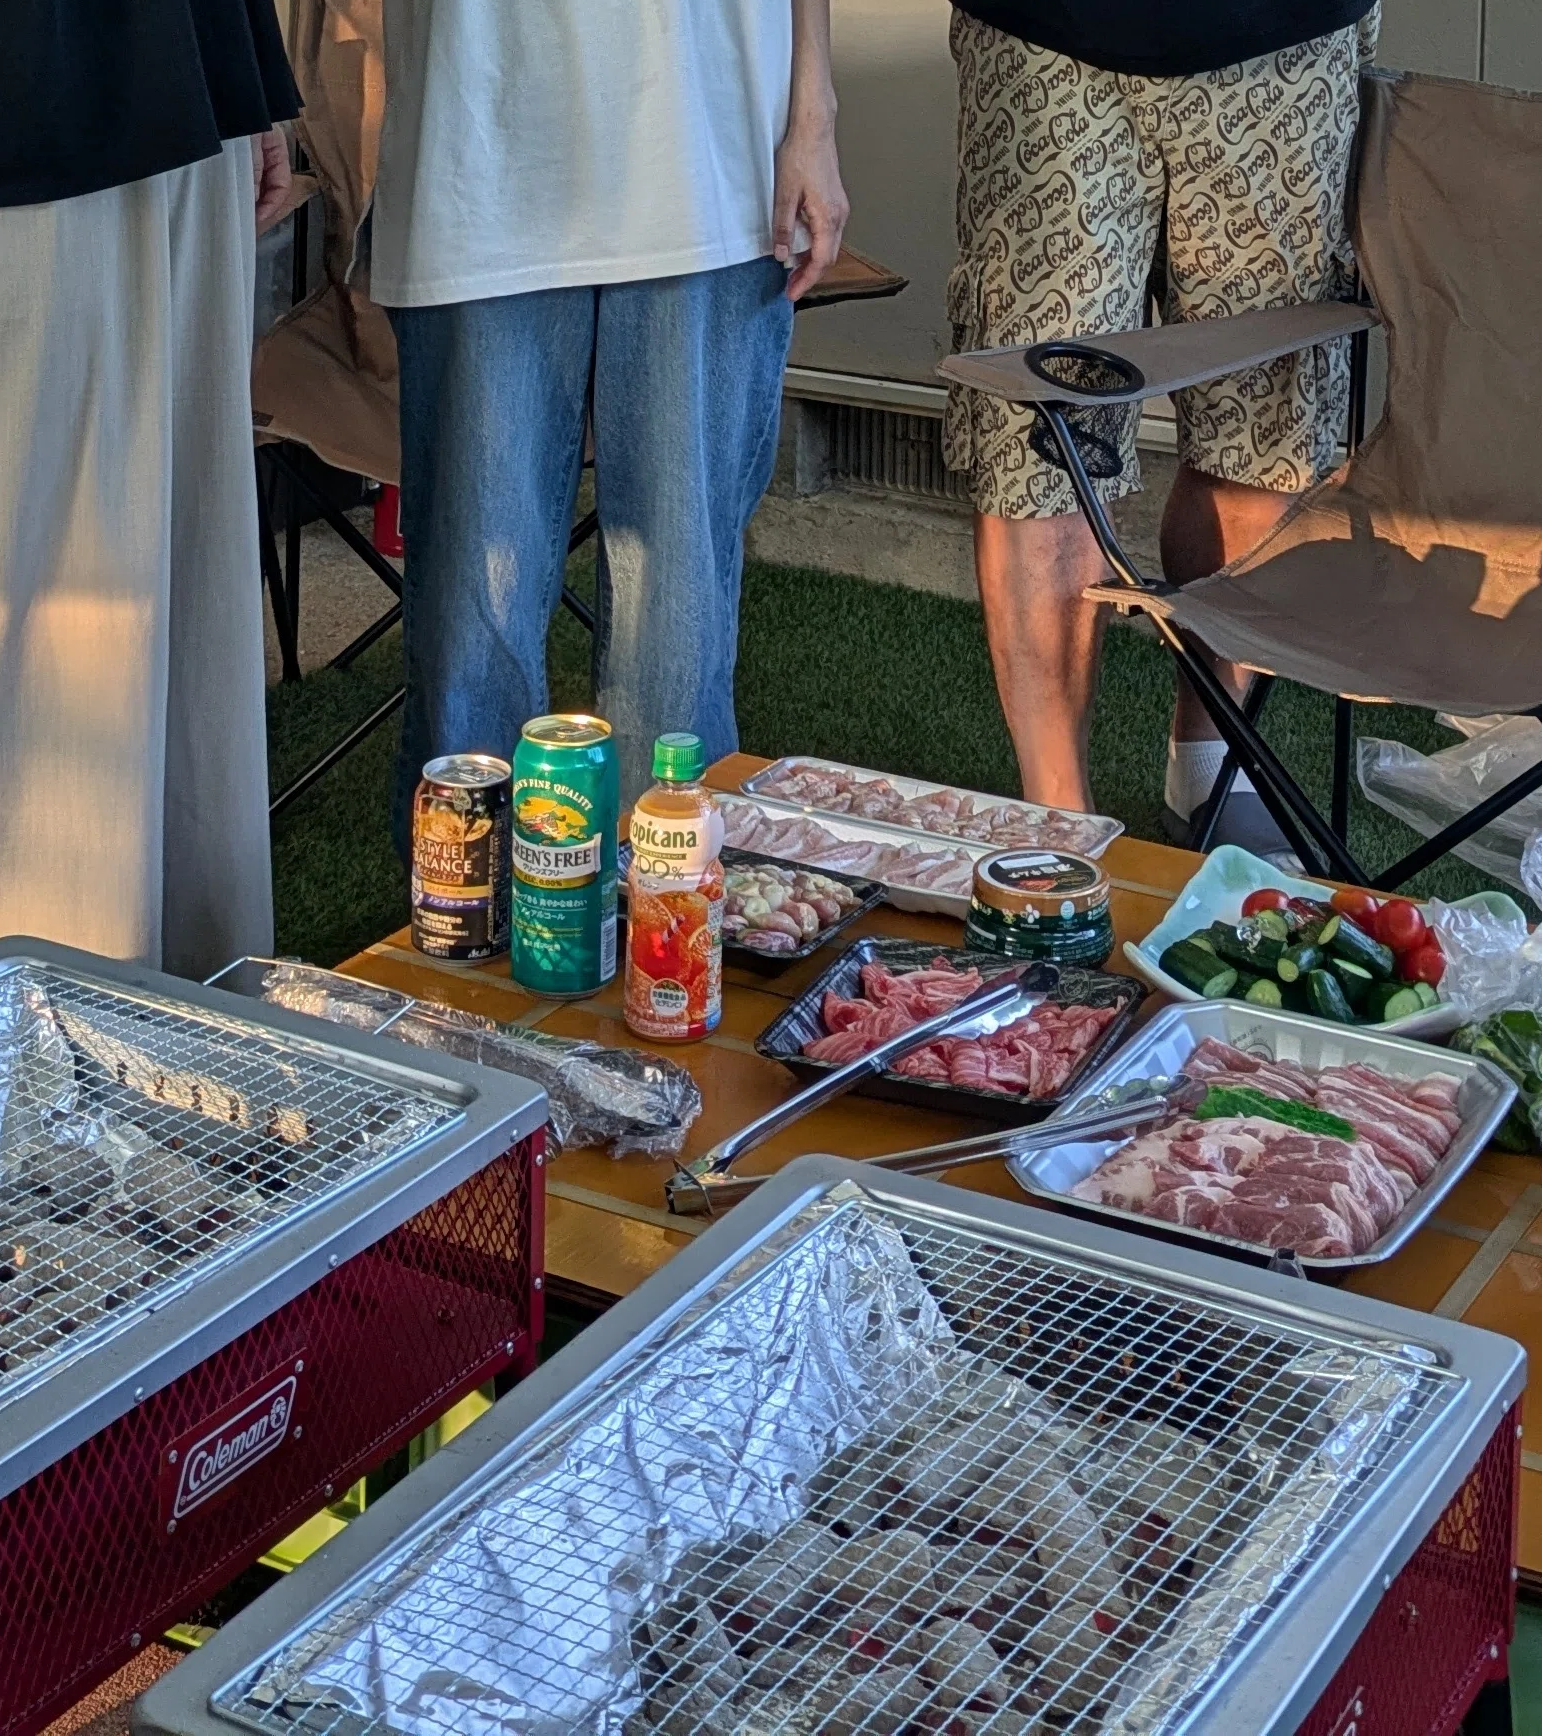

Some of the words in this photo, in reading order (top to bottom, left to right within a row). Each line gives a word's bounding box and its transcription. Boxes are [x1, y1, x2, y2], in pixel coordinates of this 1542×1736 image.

[1248, 59, 1269, 80] DRINK
[1054, 88, 1077, 109] DRINK
[1219, 89, 1240, 109] DRINK
[1217, 77, 1284, 145] Coca-Cola
[1021, 117, 1043, 137] DRINK
[1188, 119, 1209, 138] DRINK
[1016, 108, 1089, 175] Coca-Cola
[1285, 145, 1306, 164] DRINK
[1210, 138, 1278, 202] Coca-Cola
[1083, 179, 1101, 199] DRINK
[1256, 173, 1274, 192] DRINK
[1004, 170, 1076, 238] Coca-Cola
[1078, 167, 1136, 237] Coca-Cola
[1048, 208, 1071, 228] DRINK
[1224, 190, 1290, 250] Coca-Cola
[1197, 226, 1218, 243] DRINK
[1015, 236, 1038, 256] DRINK
[1010, 226, 1083, 294] Coca-Cola
[1170, 241, 1234, 295] Coca-Cola
[1222, 247, 1288, 304] Coca-Cola
[1078, 297, 1099, 318] DRINK
[553, 784, 594, 811] QUALITY
[420, 837, 459, 858] STYLE
[554, 849, 591, 868] FREE
[187, 1414, 268, 1492] Coleman
